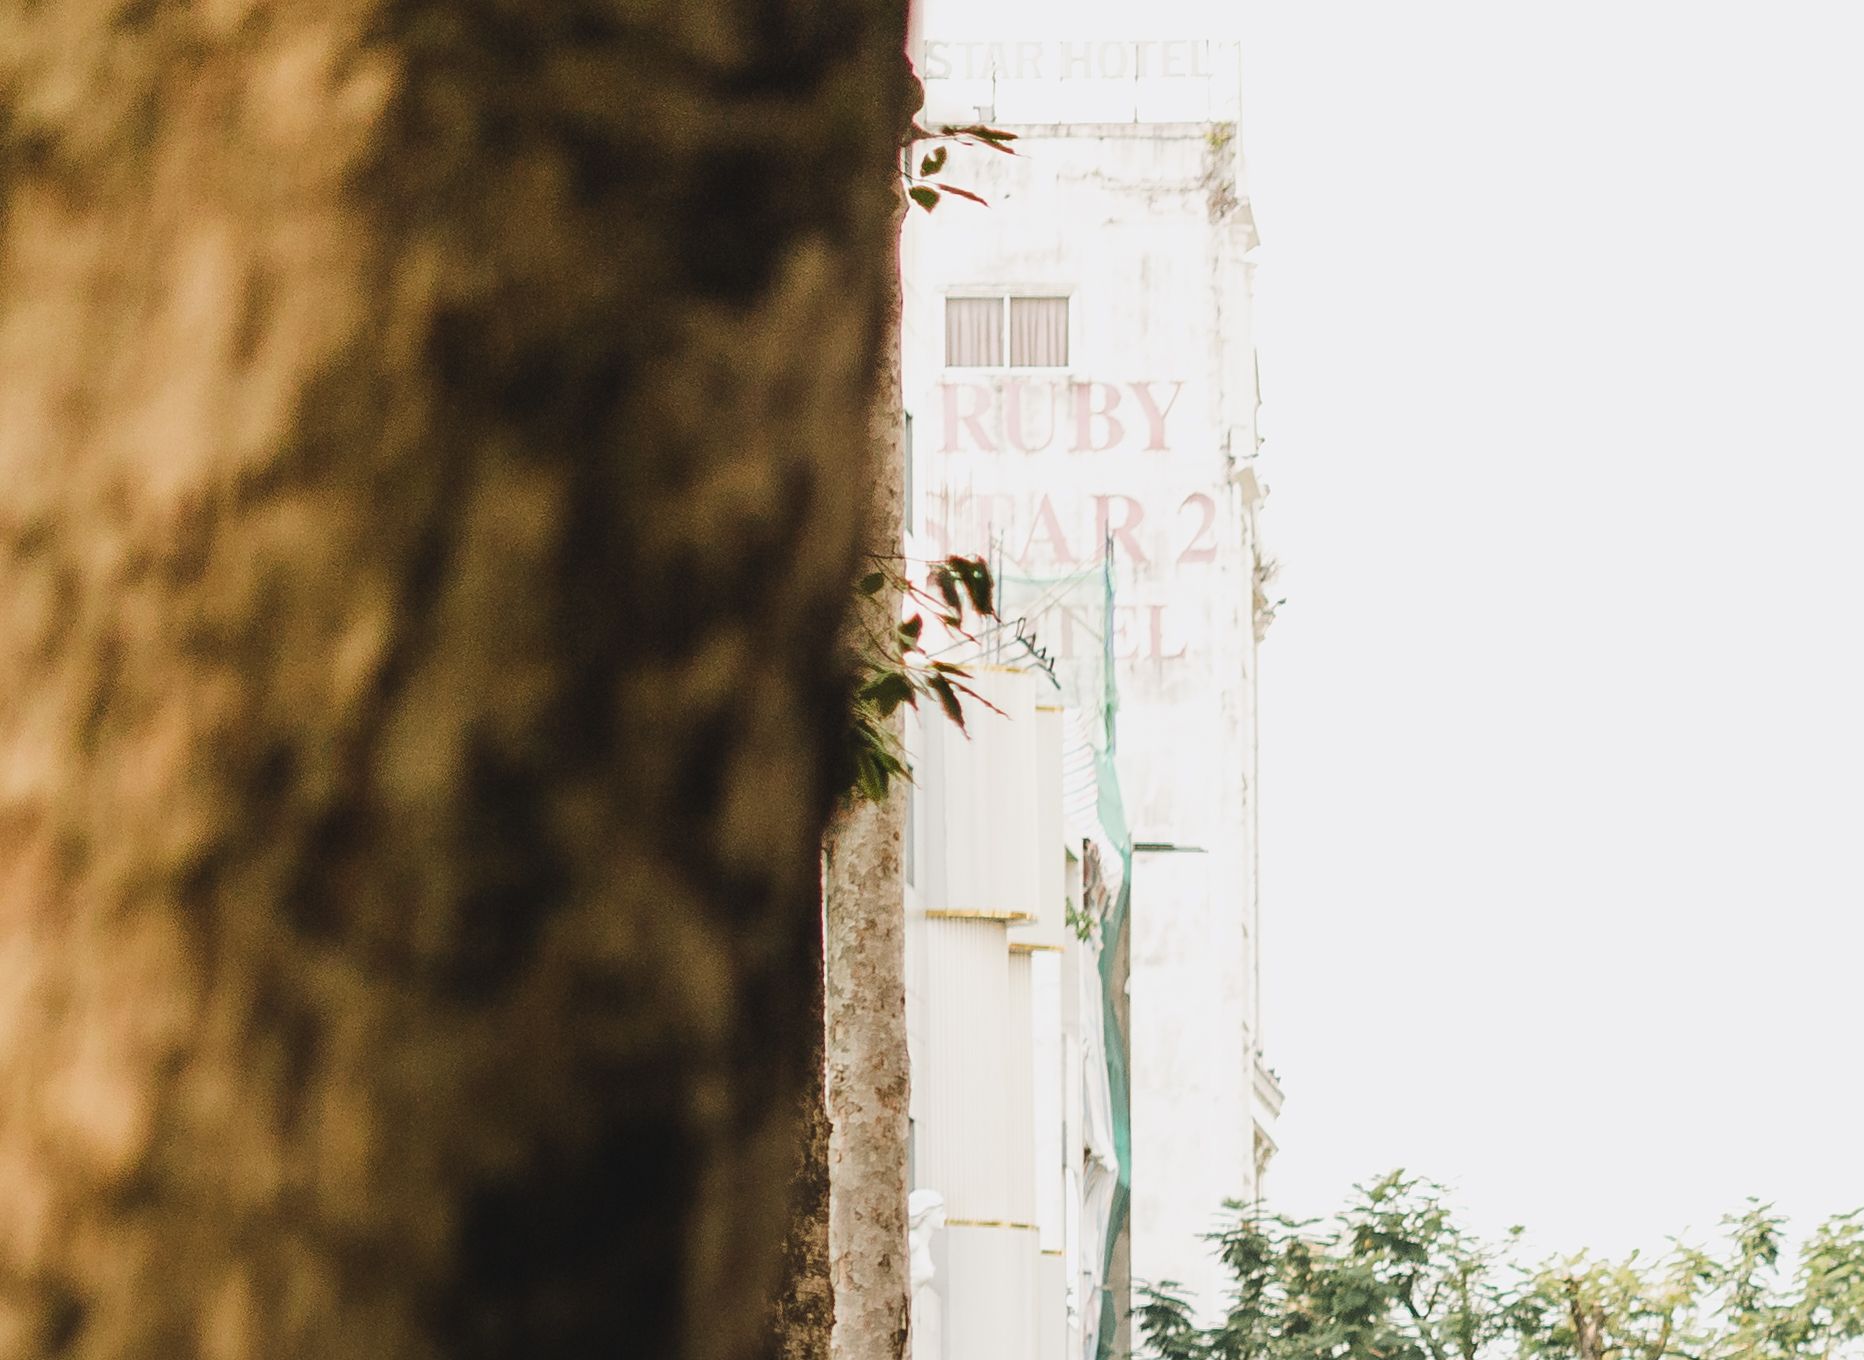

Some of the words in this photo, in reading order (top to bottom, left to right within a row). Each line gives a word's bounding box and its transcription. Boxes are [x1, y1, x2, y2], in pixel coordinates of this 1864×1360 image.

[925, 39, 1043, 80] STAR
[1061, 39, 1214, 80] HOTEL
[937, 379, 1186, 454] RUBY
[1178, 492, 1218, 564] 2
